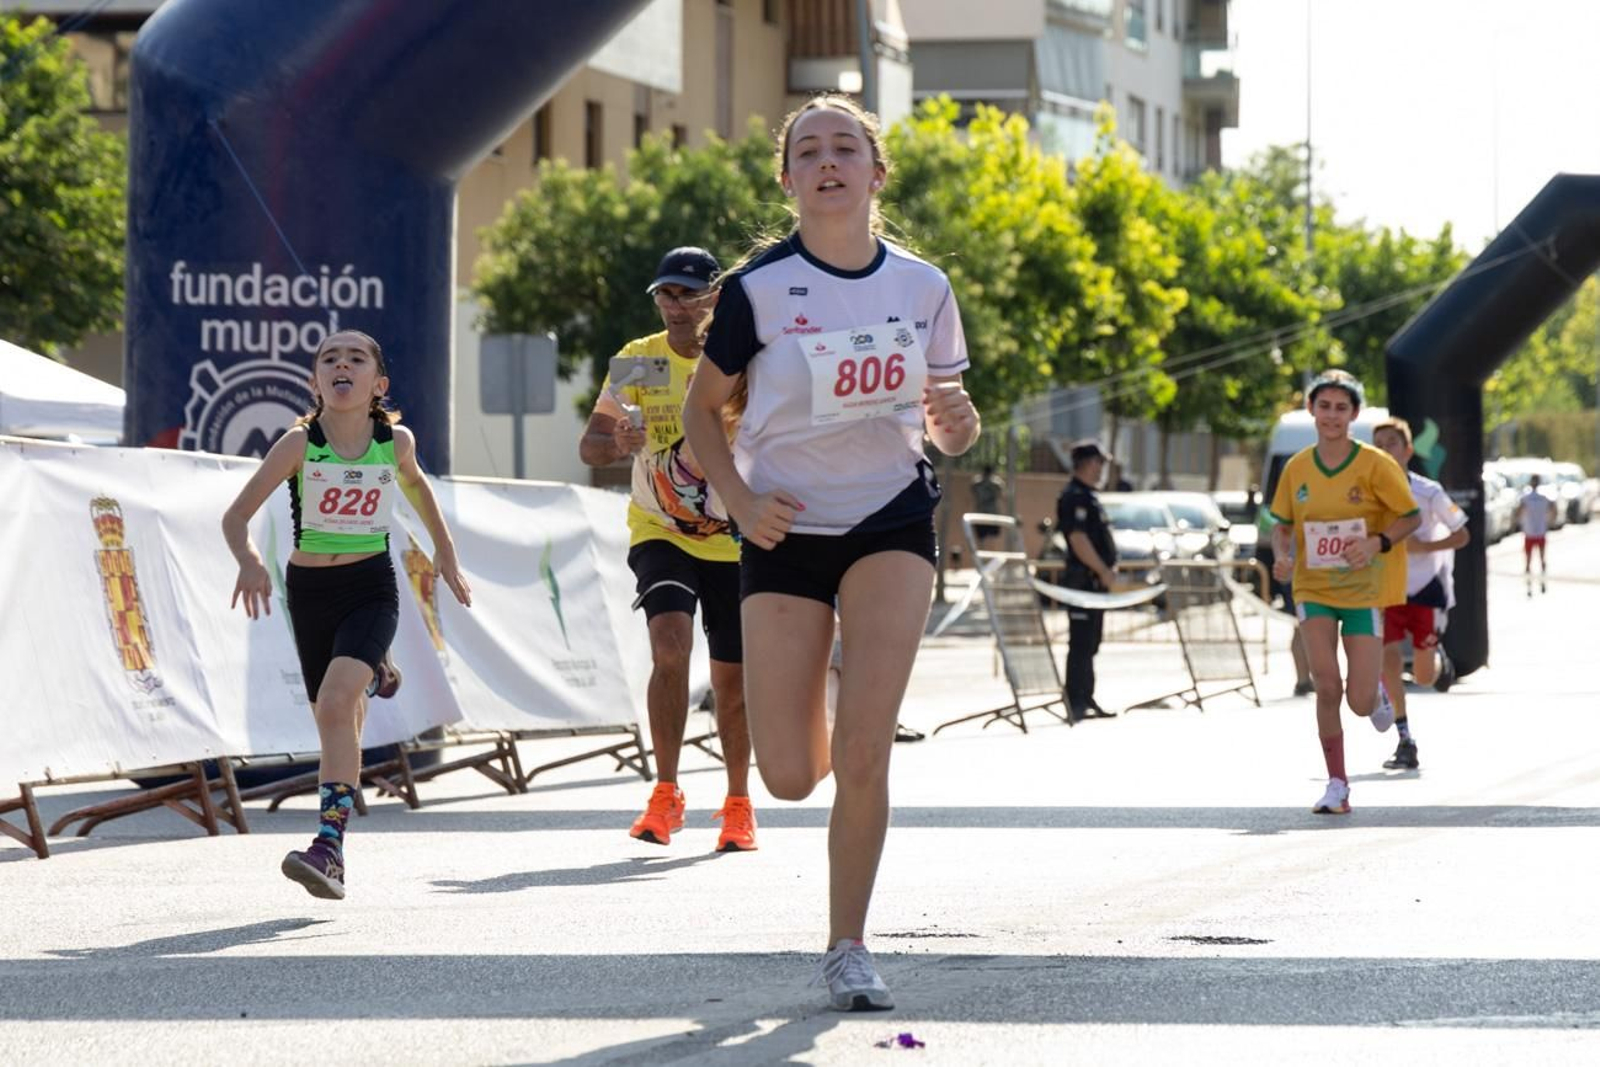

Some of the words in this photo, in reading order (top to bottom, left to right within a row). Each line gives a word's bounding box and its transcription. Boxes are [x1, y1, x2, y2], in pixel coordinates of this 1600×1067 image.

[170, 260, 384, 309] fundación
[833, 353, 906, 397] 806
[319, 487, 381, 517] 828
